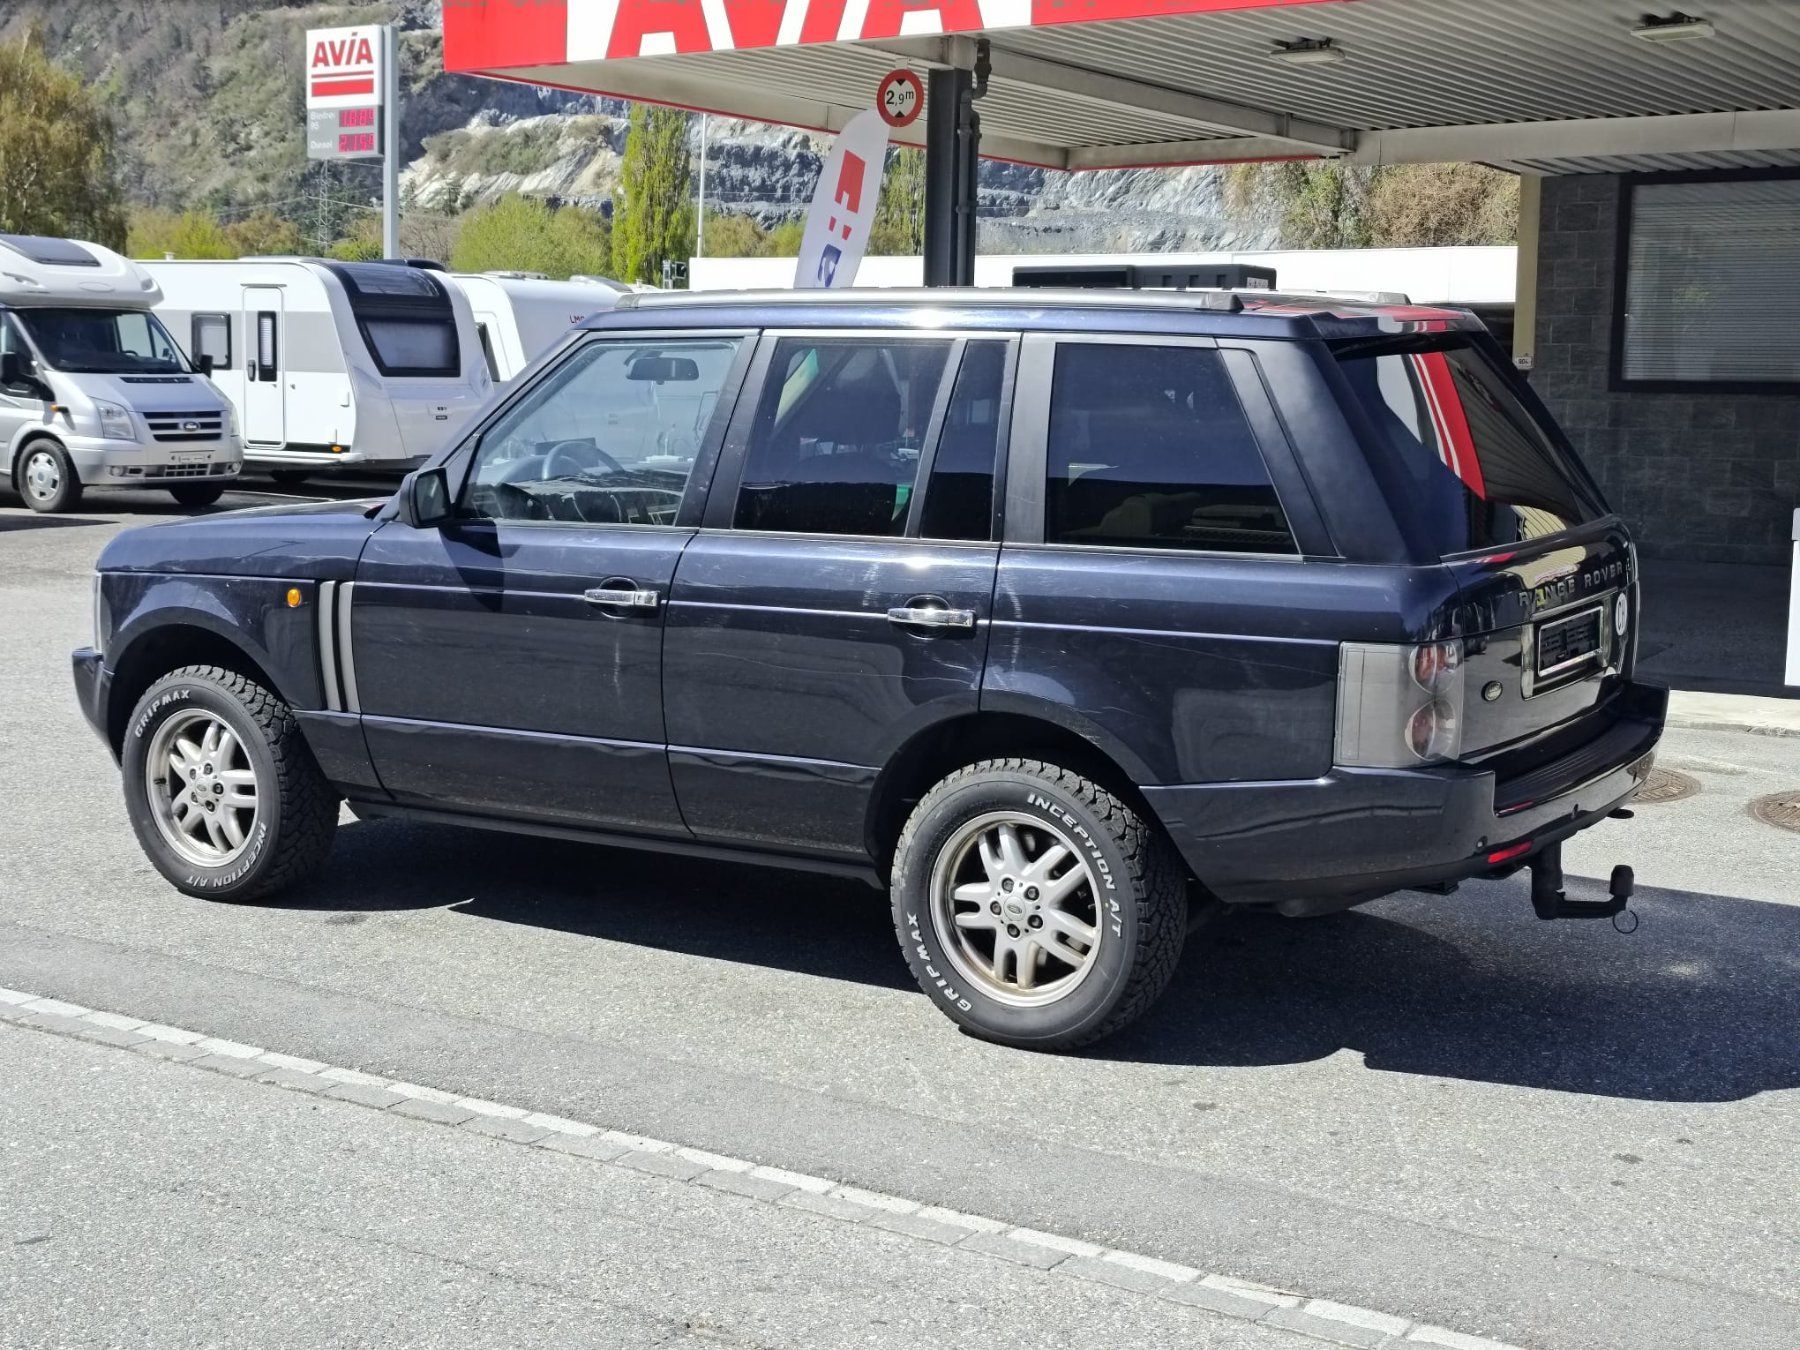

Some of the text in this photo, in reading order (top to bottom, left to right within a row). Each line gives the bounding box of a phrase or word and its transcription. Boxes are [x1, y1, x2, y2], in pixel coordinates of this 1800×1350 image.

[312, 32, 374, 68] AVIA
[1518, 561, 1623, 608] RANGE ROVER
[135, 690, 190, 738] GRIPMAX
[186, 821, 267, 888] INCEPTION A/T
[1027, 793, 1123, 938] INCEPTION A/T
[906, 911, 972, 1012] GRIPMAX
